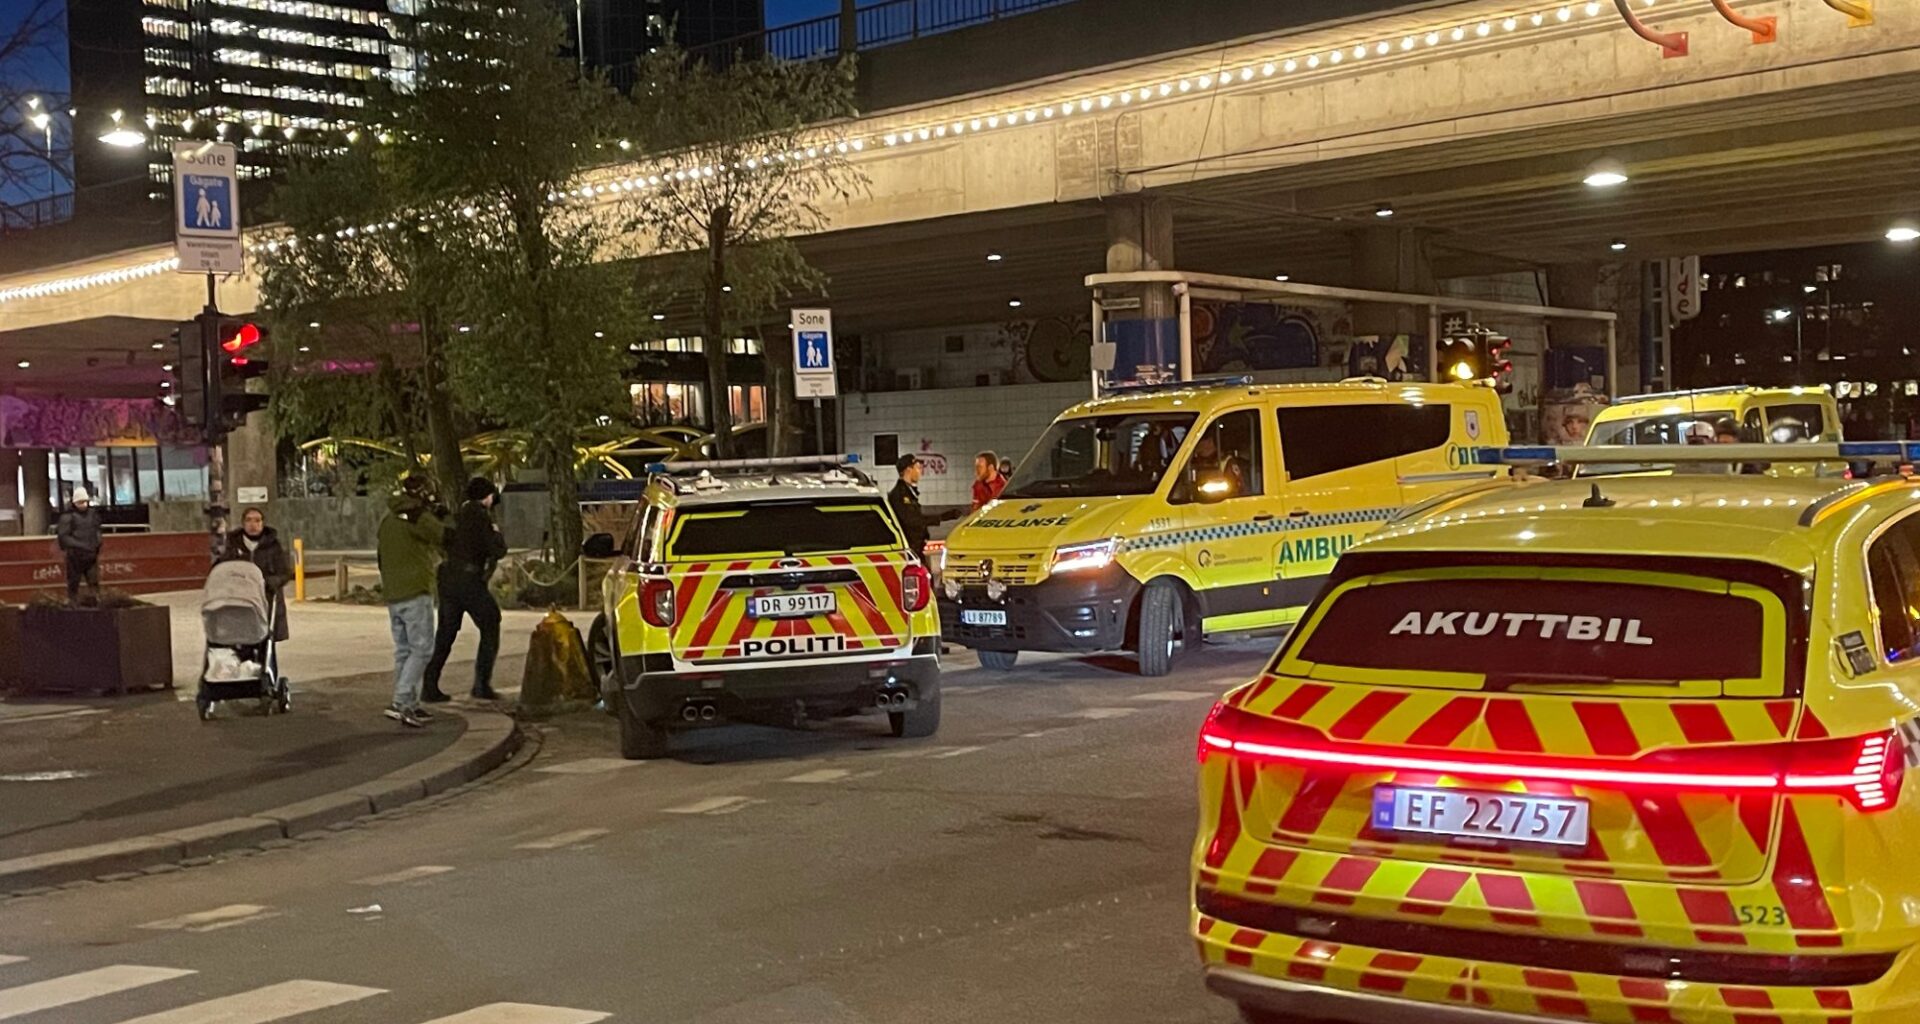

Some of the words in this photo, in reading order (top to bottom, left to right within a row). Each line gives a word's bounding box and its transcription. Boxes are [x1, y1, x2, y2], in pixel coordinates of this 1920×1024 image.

[798, 312, 825, 325] Sone
[761, 599, 781, 613] DR
[788, 595, 830, 610] 99117
[1389, 611, 1653, 645] AKUTTBIL
[743, 635, 845, 657] POLITI
[1407, 793, 1447, 829] EF
[1462, 797, 1577, 838] 22757
